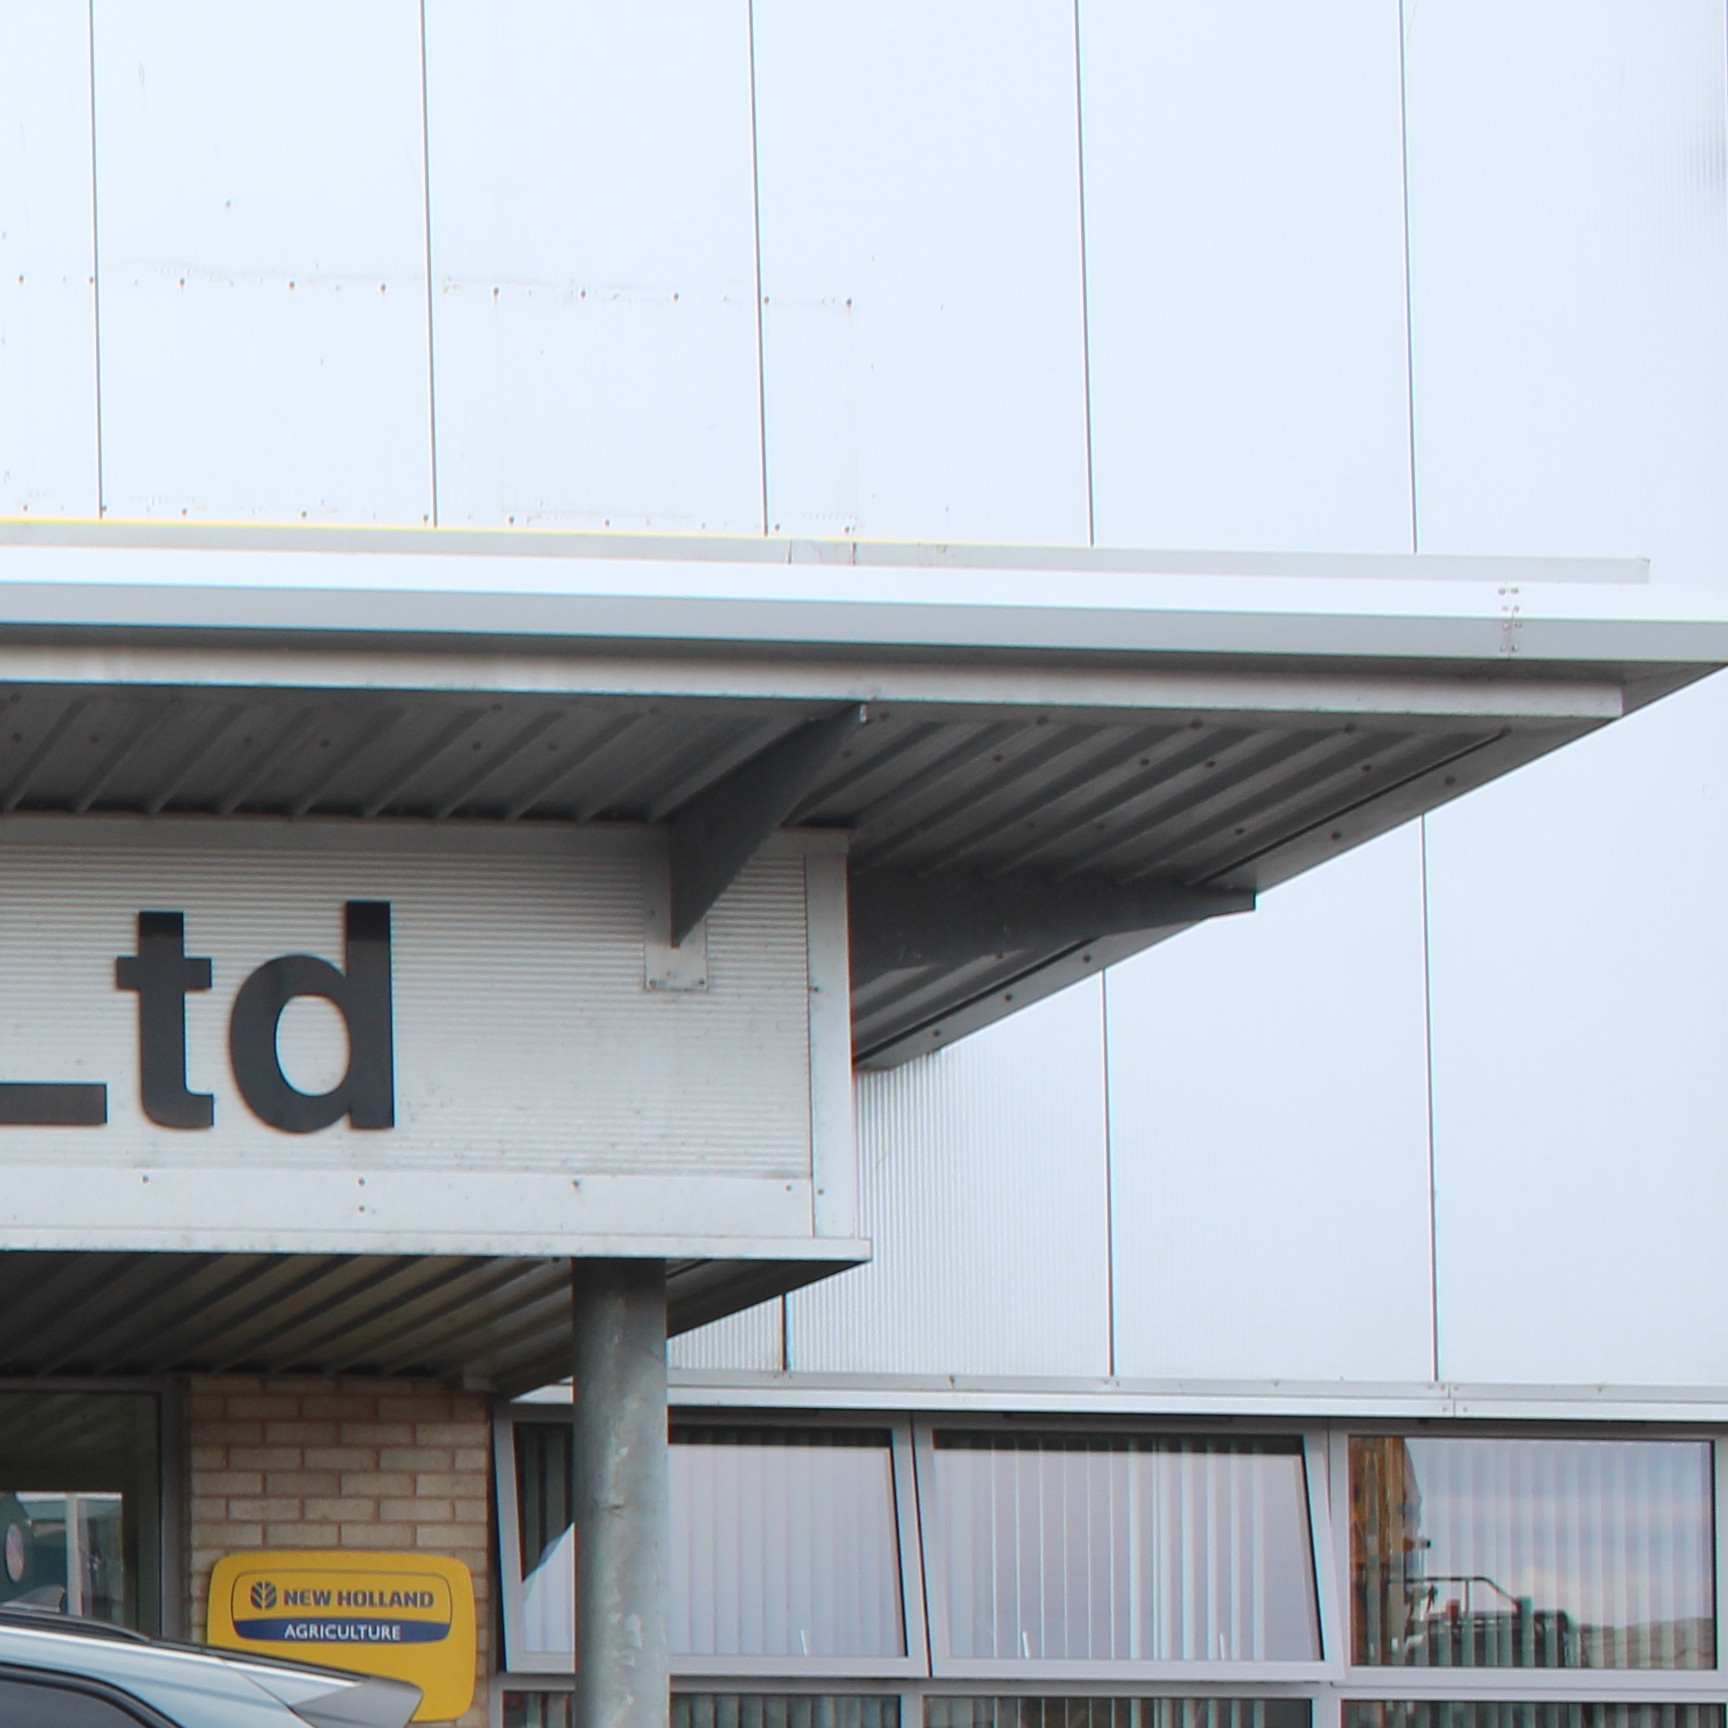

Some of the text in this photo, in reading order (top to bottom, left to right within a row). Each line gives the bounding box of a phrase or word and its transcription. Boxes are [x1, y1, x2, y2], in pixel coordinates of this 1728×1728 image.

[283, 1590, 434, 1608] NEW HOLLAND
[284, 1624, 401, 1641] AGRICULTURE
